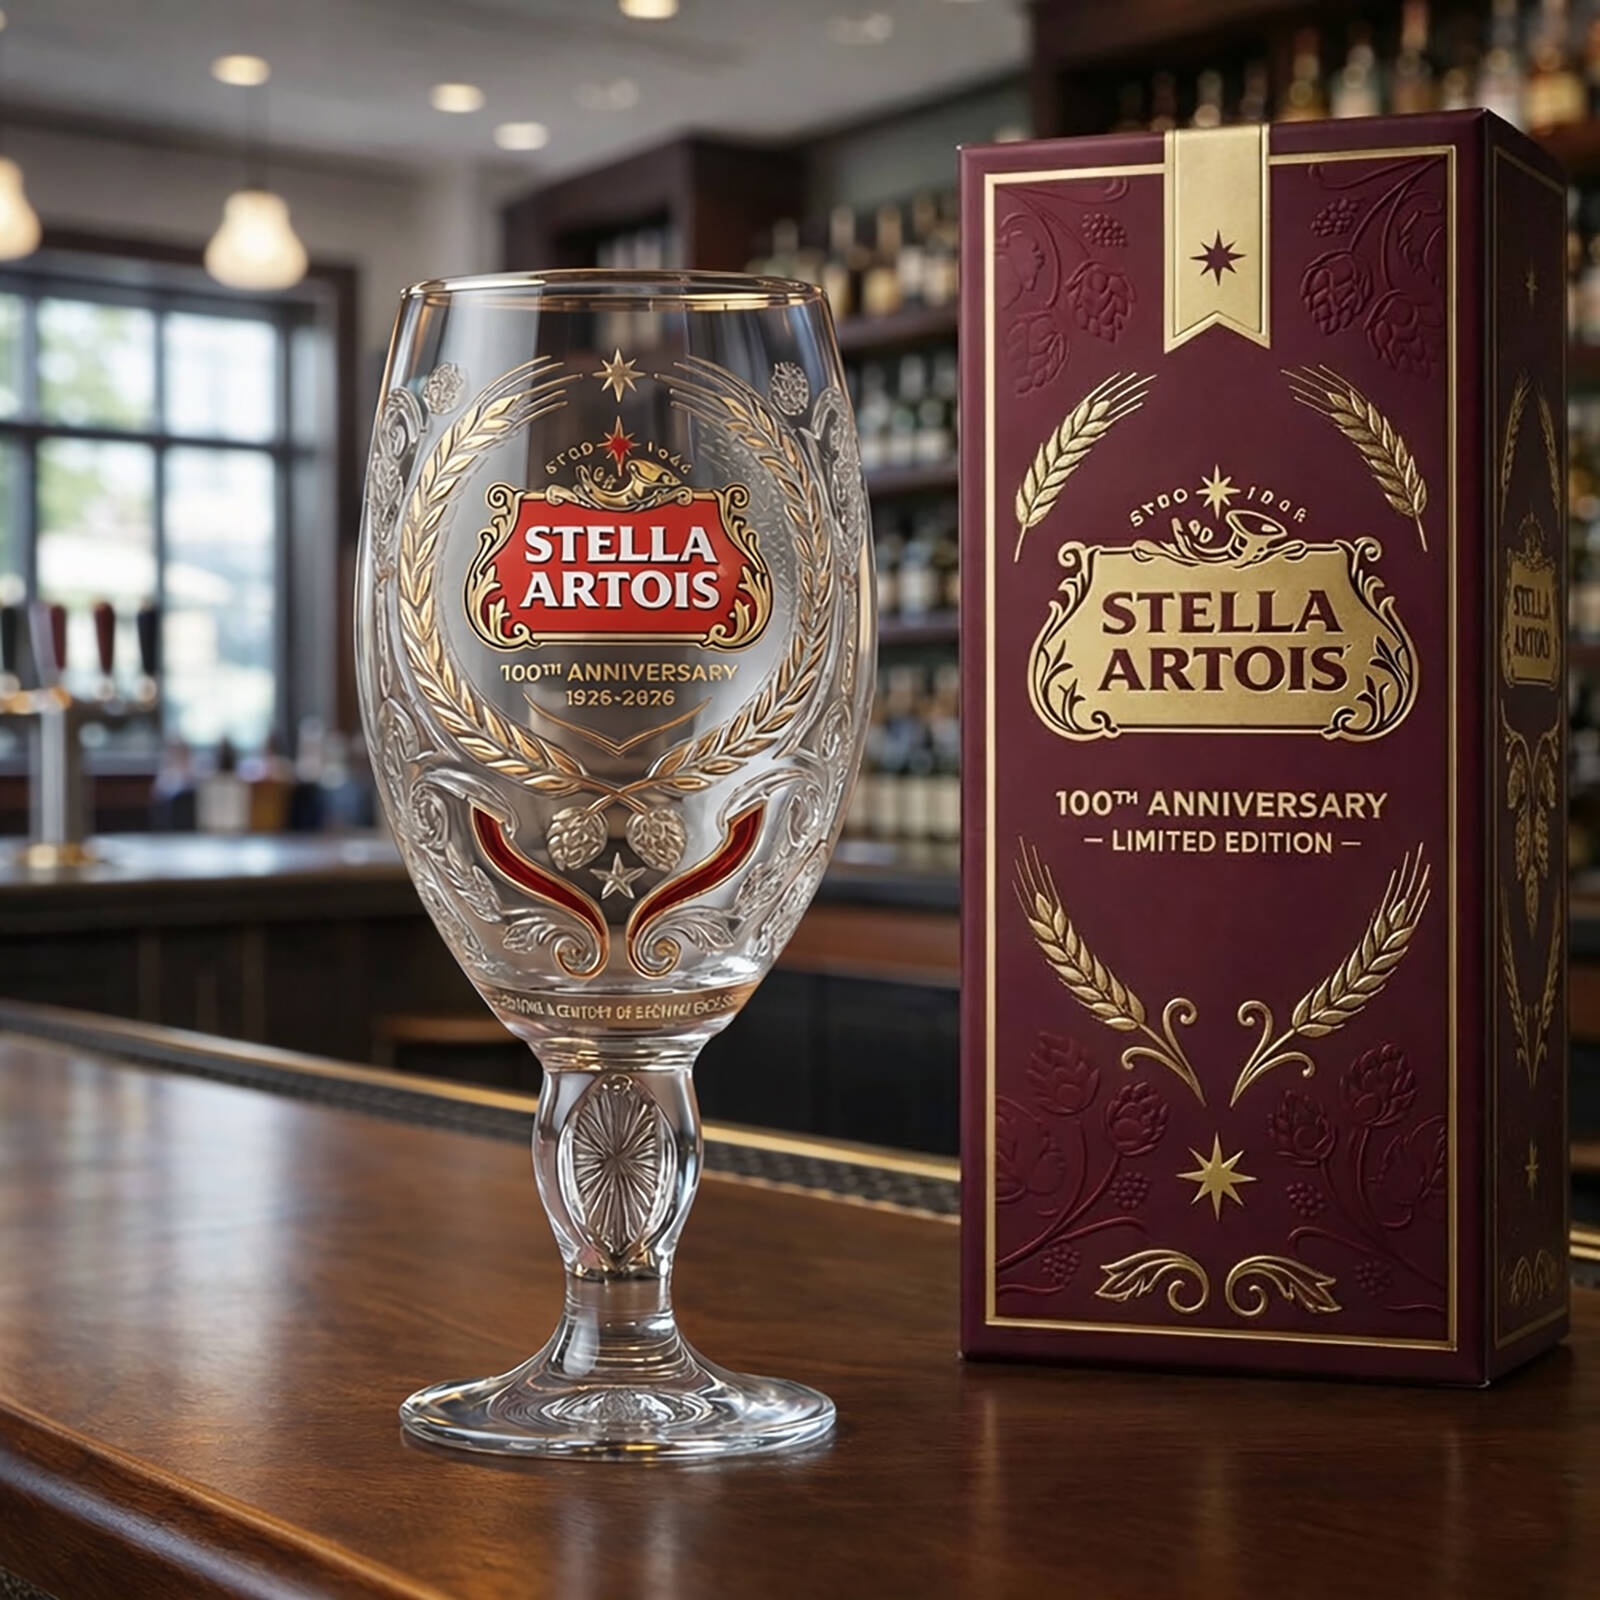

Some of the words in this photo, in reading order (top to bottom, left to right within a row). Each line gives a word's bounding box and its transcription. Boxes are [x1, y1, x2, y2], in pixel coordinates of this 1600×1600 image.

[524, 525, 719, 564] STELLA
[519, 570, 720, 610] ARTOIS
[1101, 589, 1344, 635] STELLA
[567, 663, 739, 682] ANNIVERSARY
[1097, 645, 1349, 693] ARTOIS
[1056, 790, 1139, 817] 100TH
[1147, 791, 1389, 819] ANNIVERSARY
[1112, 829, 1217, 852] LIMITED
[1225, 830, 1333, 854] EDITION
